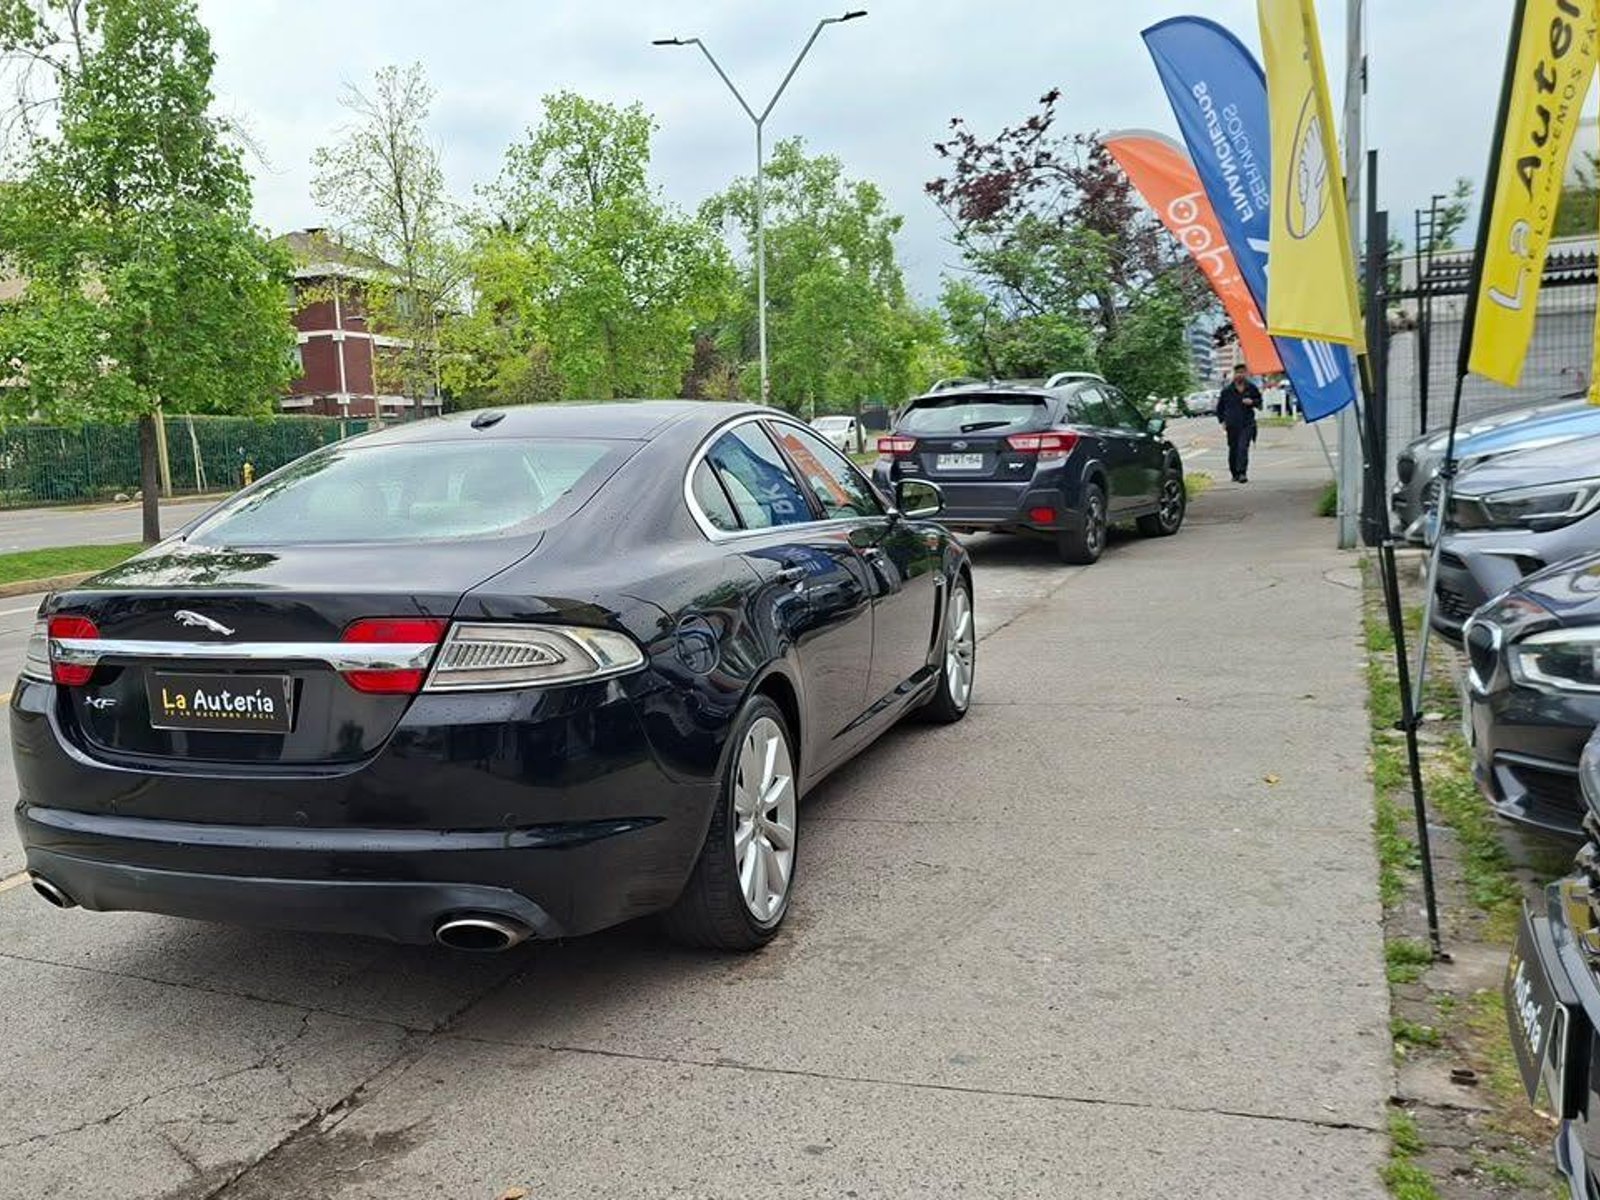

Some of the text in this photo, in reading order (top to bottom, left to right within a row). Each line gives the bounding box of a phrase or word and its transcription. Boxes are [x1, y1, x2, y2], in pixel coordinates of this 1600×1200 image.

[1487, 218, 1529, 310] La
[83, 696, 117, 709] XF
[162, 688, 274, 712] La Autería
